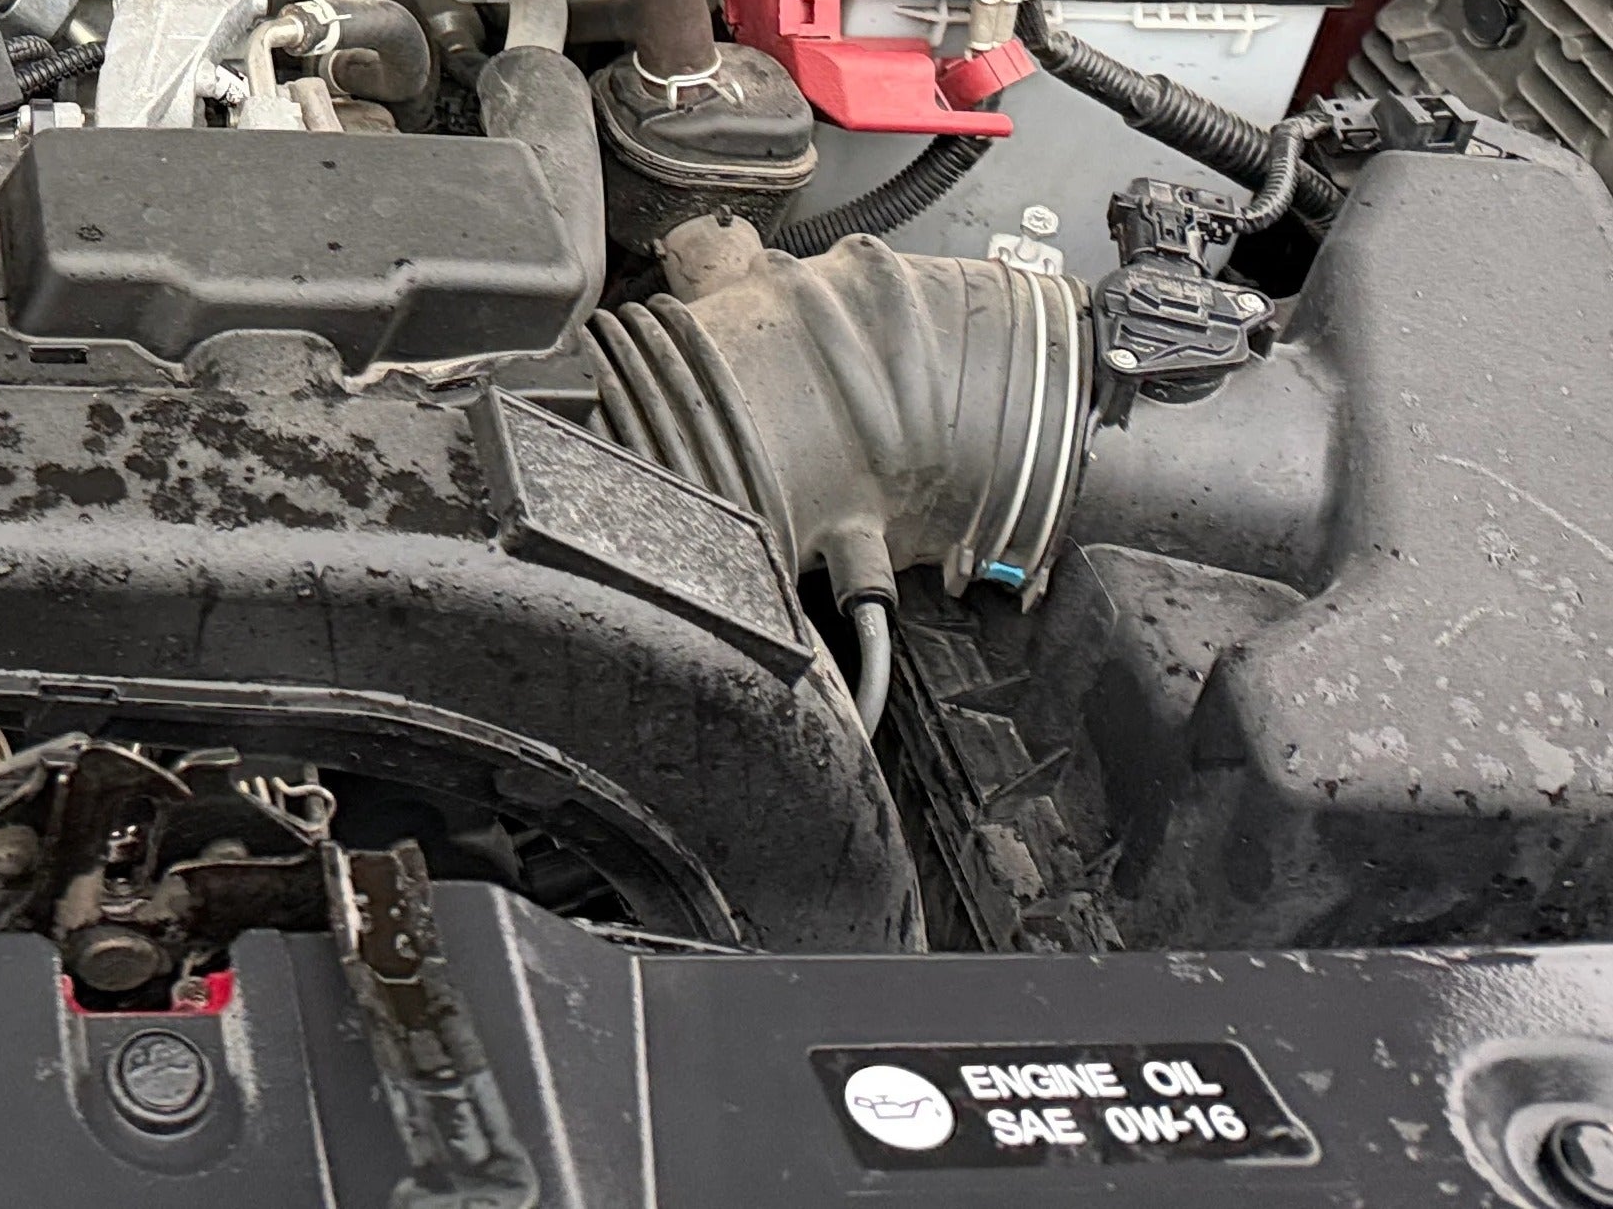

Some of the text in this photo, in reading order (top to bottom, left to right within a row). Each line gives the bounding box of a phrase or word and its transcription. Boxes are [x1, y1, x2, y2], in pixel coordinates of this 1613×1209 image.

[960, 1061, 1224, 1100] ENGINE OIL
[987, 1103, 1248, 1145] SAE 0W-16
